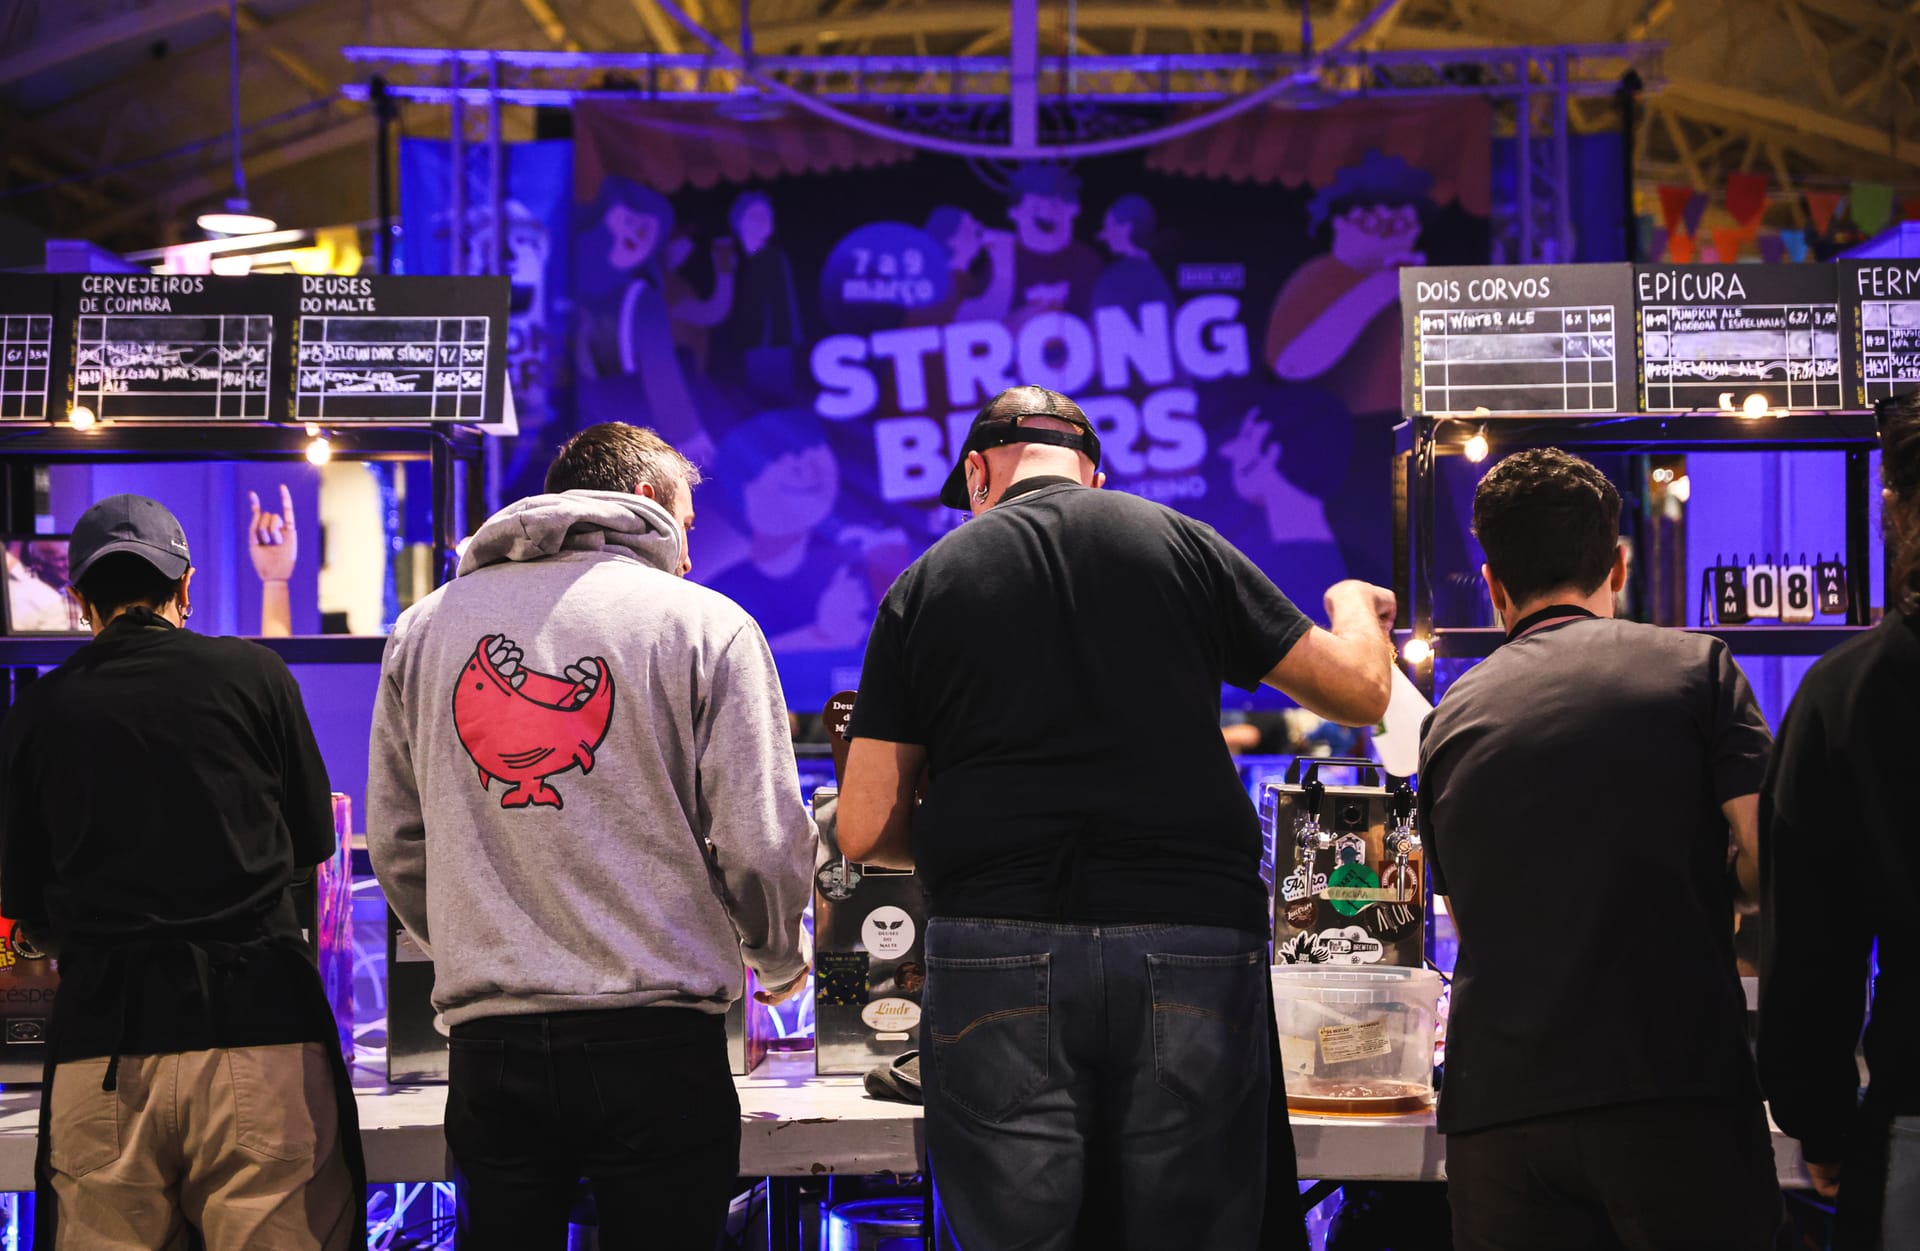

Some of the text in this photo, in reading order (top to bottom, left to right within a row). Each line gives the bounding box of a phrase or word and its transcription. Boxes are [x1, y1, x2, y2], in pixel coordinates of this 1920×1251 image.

[853, 248, 924, 276] 7 a 9
[82, 275, 204, 295] CERVEJEIROS
[302, 276, 371, 295] DEUSES
[842, 278, 935, 308] março
[1417, 277, 1550, 302] DOIS CORVOS
[1639, 270, 1746, 301] EPICURA
[80, 297, 172, 313] DE COIMBRA
[300, 297, 376, 312] DO MALTE
[1721, 306, 1743, 319] ALE
[1450, 311, 1503, 330] WINTER
[1507, 311, 1535, 326] ALE
[810, 294, 1250, 419] STRONG
[875, 387, 1208, 502] BRS
[1753, 572, 1808, 609] 08
[1824, 567, 1839, 605] MAR
[833, 701, 854, 710] Deu
